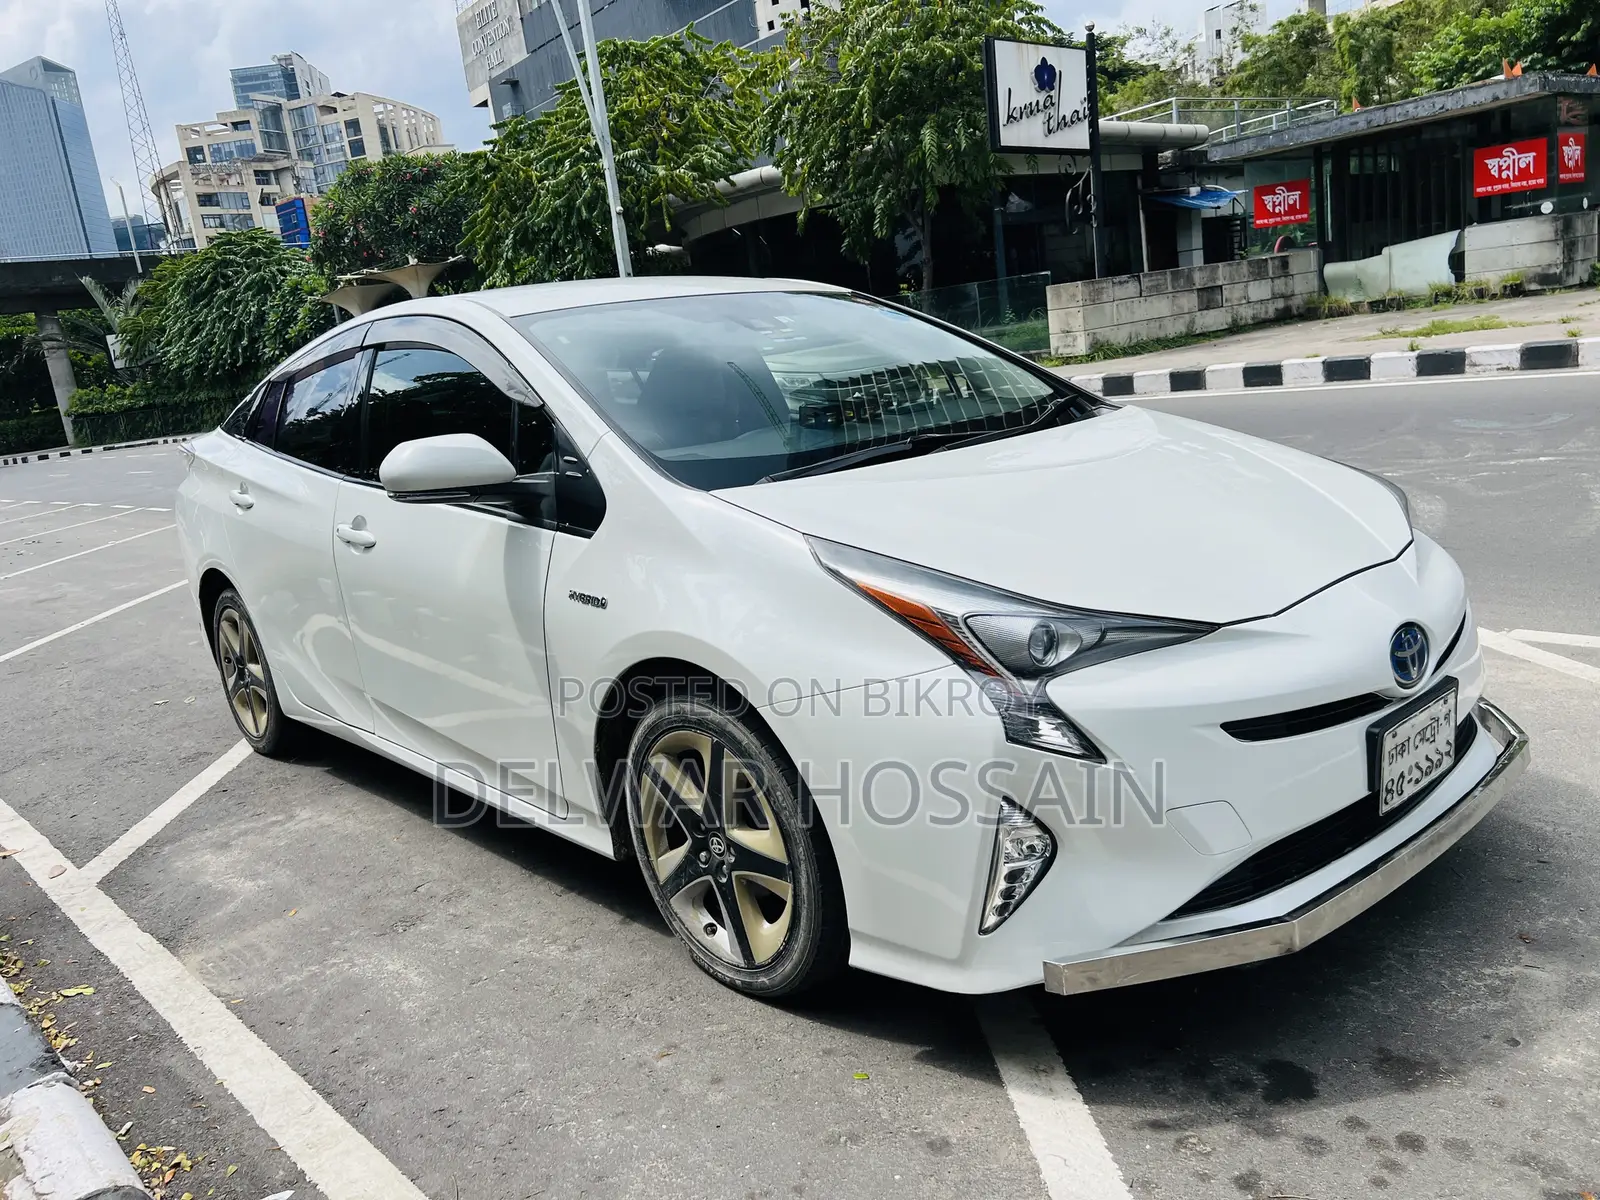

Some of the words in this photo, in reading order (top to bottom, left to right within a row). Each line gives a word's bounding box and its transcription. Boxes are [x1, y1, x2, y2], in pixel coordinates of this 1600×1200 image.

[475, 0, 499, 30] ELITE
[472, 16, 512, 57] CONVENTION
[486, 48, 504, 70] HALL
[1003, 87, 1056, 127] krua
[1043, 70, 1089, 137] thai
[1484, 147, 1537, 181] স্বপ্নীল
[1261, 186, 1301, 215] স্বপ্নীল
[1388, 736, 1411, 766] ঢাকা
